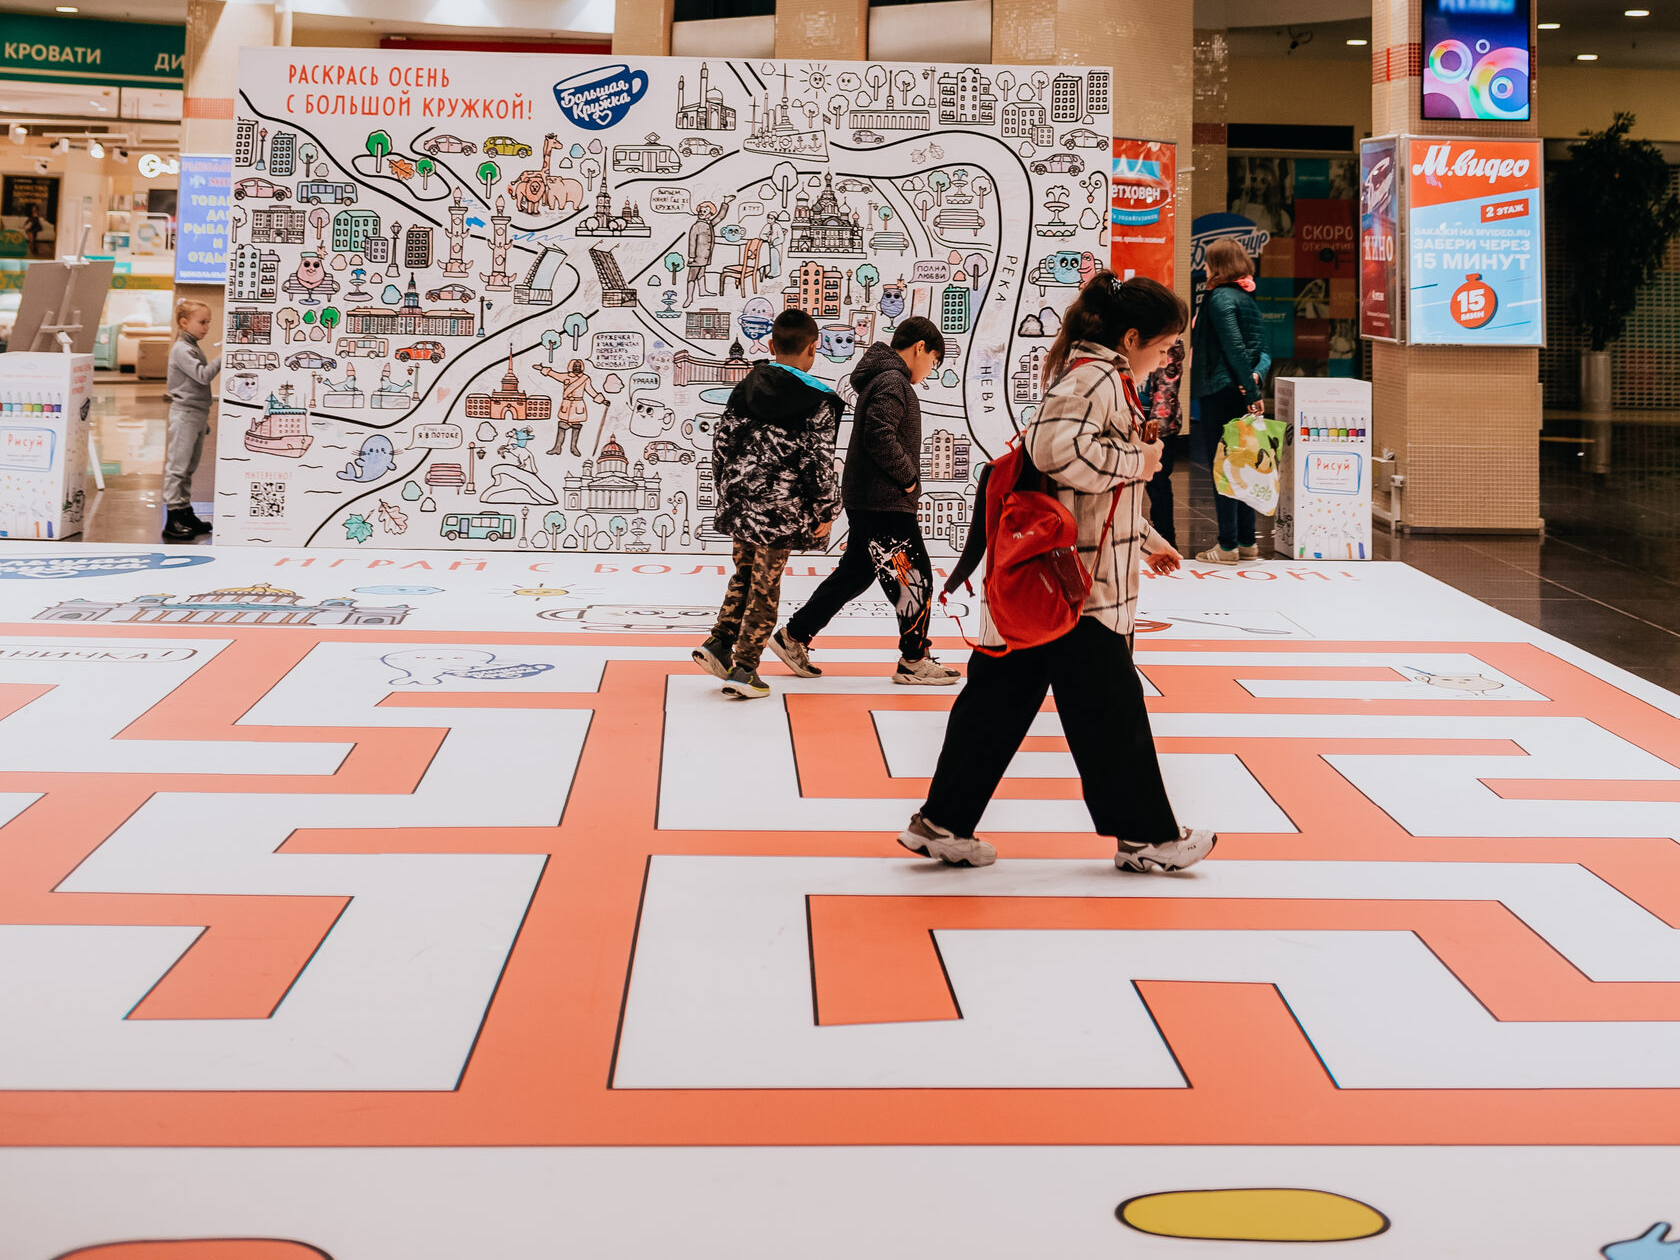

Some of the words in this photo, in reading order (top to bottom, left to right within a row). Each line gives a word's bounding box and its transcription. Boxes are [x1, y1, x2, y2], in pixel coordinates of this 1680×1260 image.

[4, 41, 102, 65] КРОВАТИ
[288, 63, 379, 86] РАСКРАСЬ
[388, 66, 450, 88] ОСЕНЬ
[286, 93, 295, 114] С
[305, 90, 411, 117] БОЛЬШОЙ
[422, 92, 533, 120] КРУЖКОЙ!
[560, 80, 629, 108] Большая
[572, 92, 631, 121] Кружка
[1485, 205, 1494, 218] 2
[1302, 225, 1353, 240] СКОРО
[1364, 235, 1394, 261] КИНО
[1413, 239, 1477, 251] ЗАБЕРИ
[1479, 239, 1531, 252] ЧЕРЕЗ
[1413, 252, 1437, 270] 15
[1443, 253, 1531, 271] МИНУТ
[994, 254, 1019, 302] РЕКА
[1456, 288, 1486, 313] 15
[979, 365, 996, 414] НЕВА
[273, 556, 489, 572] ИГРАЙ
